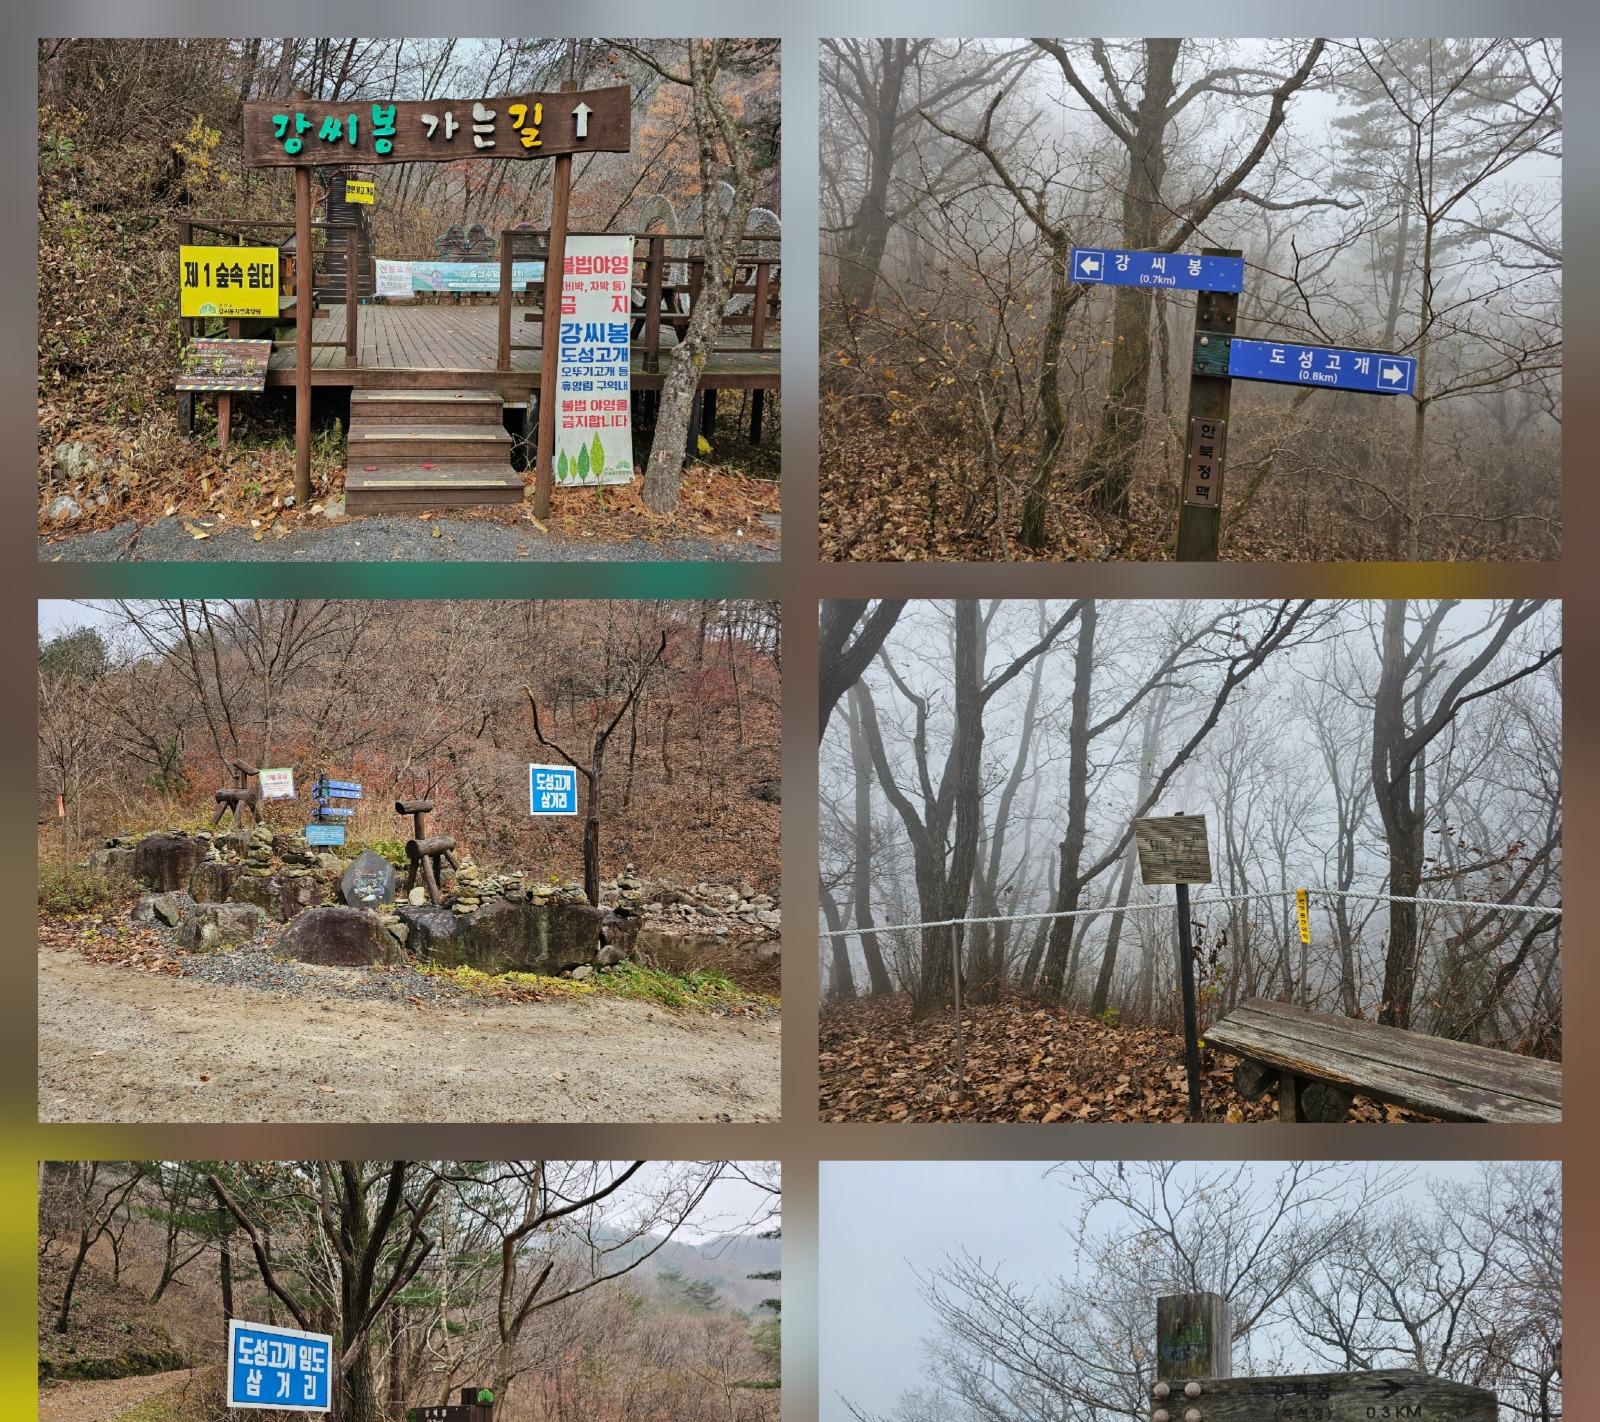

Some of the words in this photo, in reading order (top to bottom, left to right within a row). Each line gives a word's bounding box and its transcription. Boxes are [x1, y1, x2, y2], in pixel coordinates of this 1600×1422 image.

[272, 103, 396, 155] 강씨봉
[1115, 254, 1202, 277] 강씨봉
[184, 262, 198, 288] 제
[204, 263, 210, 288] 1
[216, 262, 244, 288] 숲속
[248, 263, 274, 289] 쉼터
[1139, 274, 1176, 286] (0.7km)
[590, 281, 610, 292] 차박
[612, 280, 626, 292] 등)
[560, 322, 629, 344] 강씨봉
[562, 347, 629, 362] 도성고개
[1270, 349, 1370, 375] 도성고개
[561, 366, 615, 377] 오뚜기고개
[1299, 370, 1338, 384] (0.8km)
[562, 381, 594, 392] 휴양림
[596, 381, 628, 391] 구역내
[562, 400, 586, 412] 불법
[590, 400, 628, 412] 야영을
[562, 414, 628, 428] 금지합니다
[536, 774, 571, 791] 도성고개
[541, 792, 568, 808] 삼거리
[238, 1336, 296, 1370] 도성고개
[299, 1345, 325, 1373] 임도
